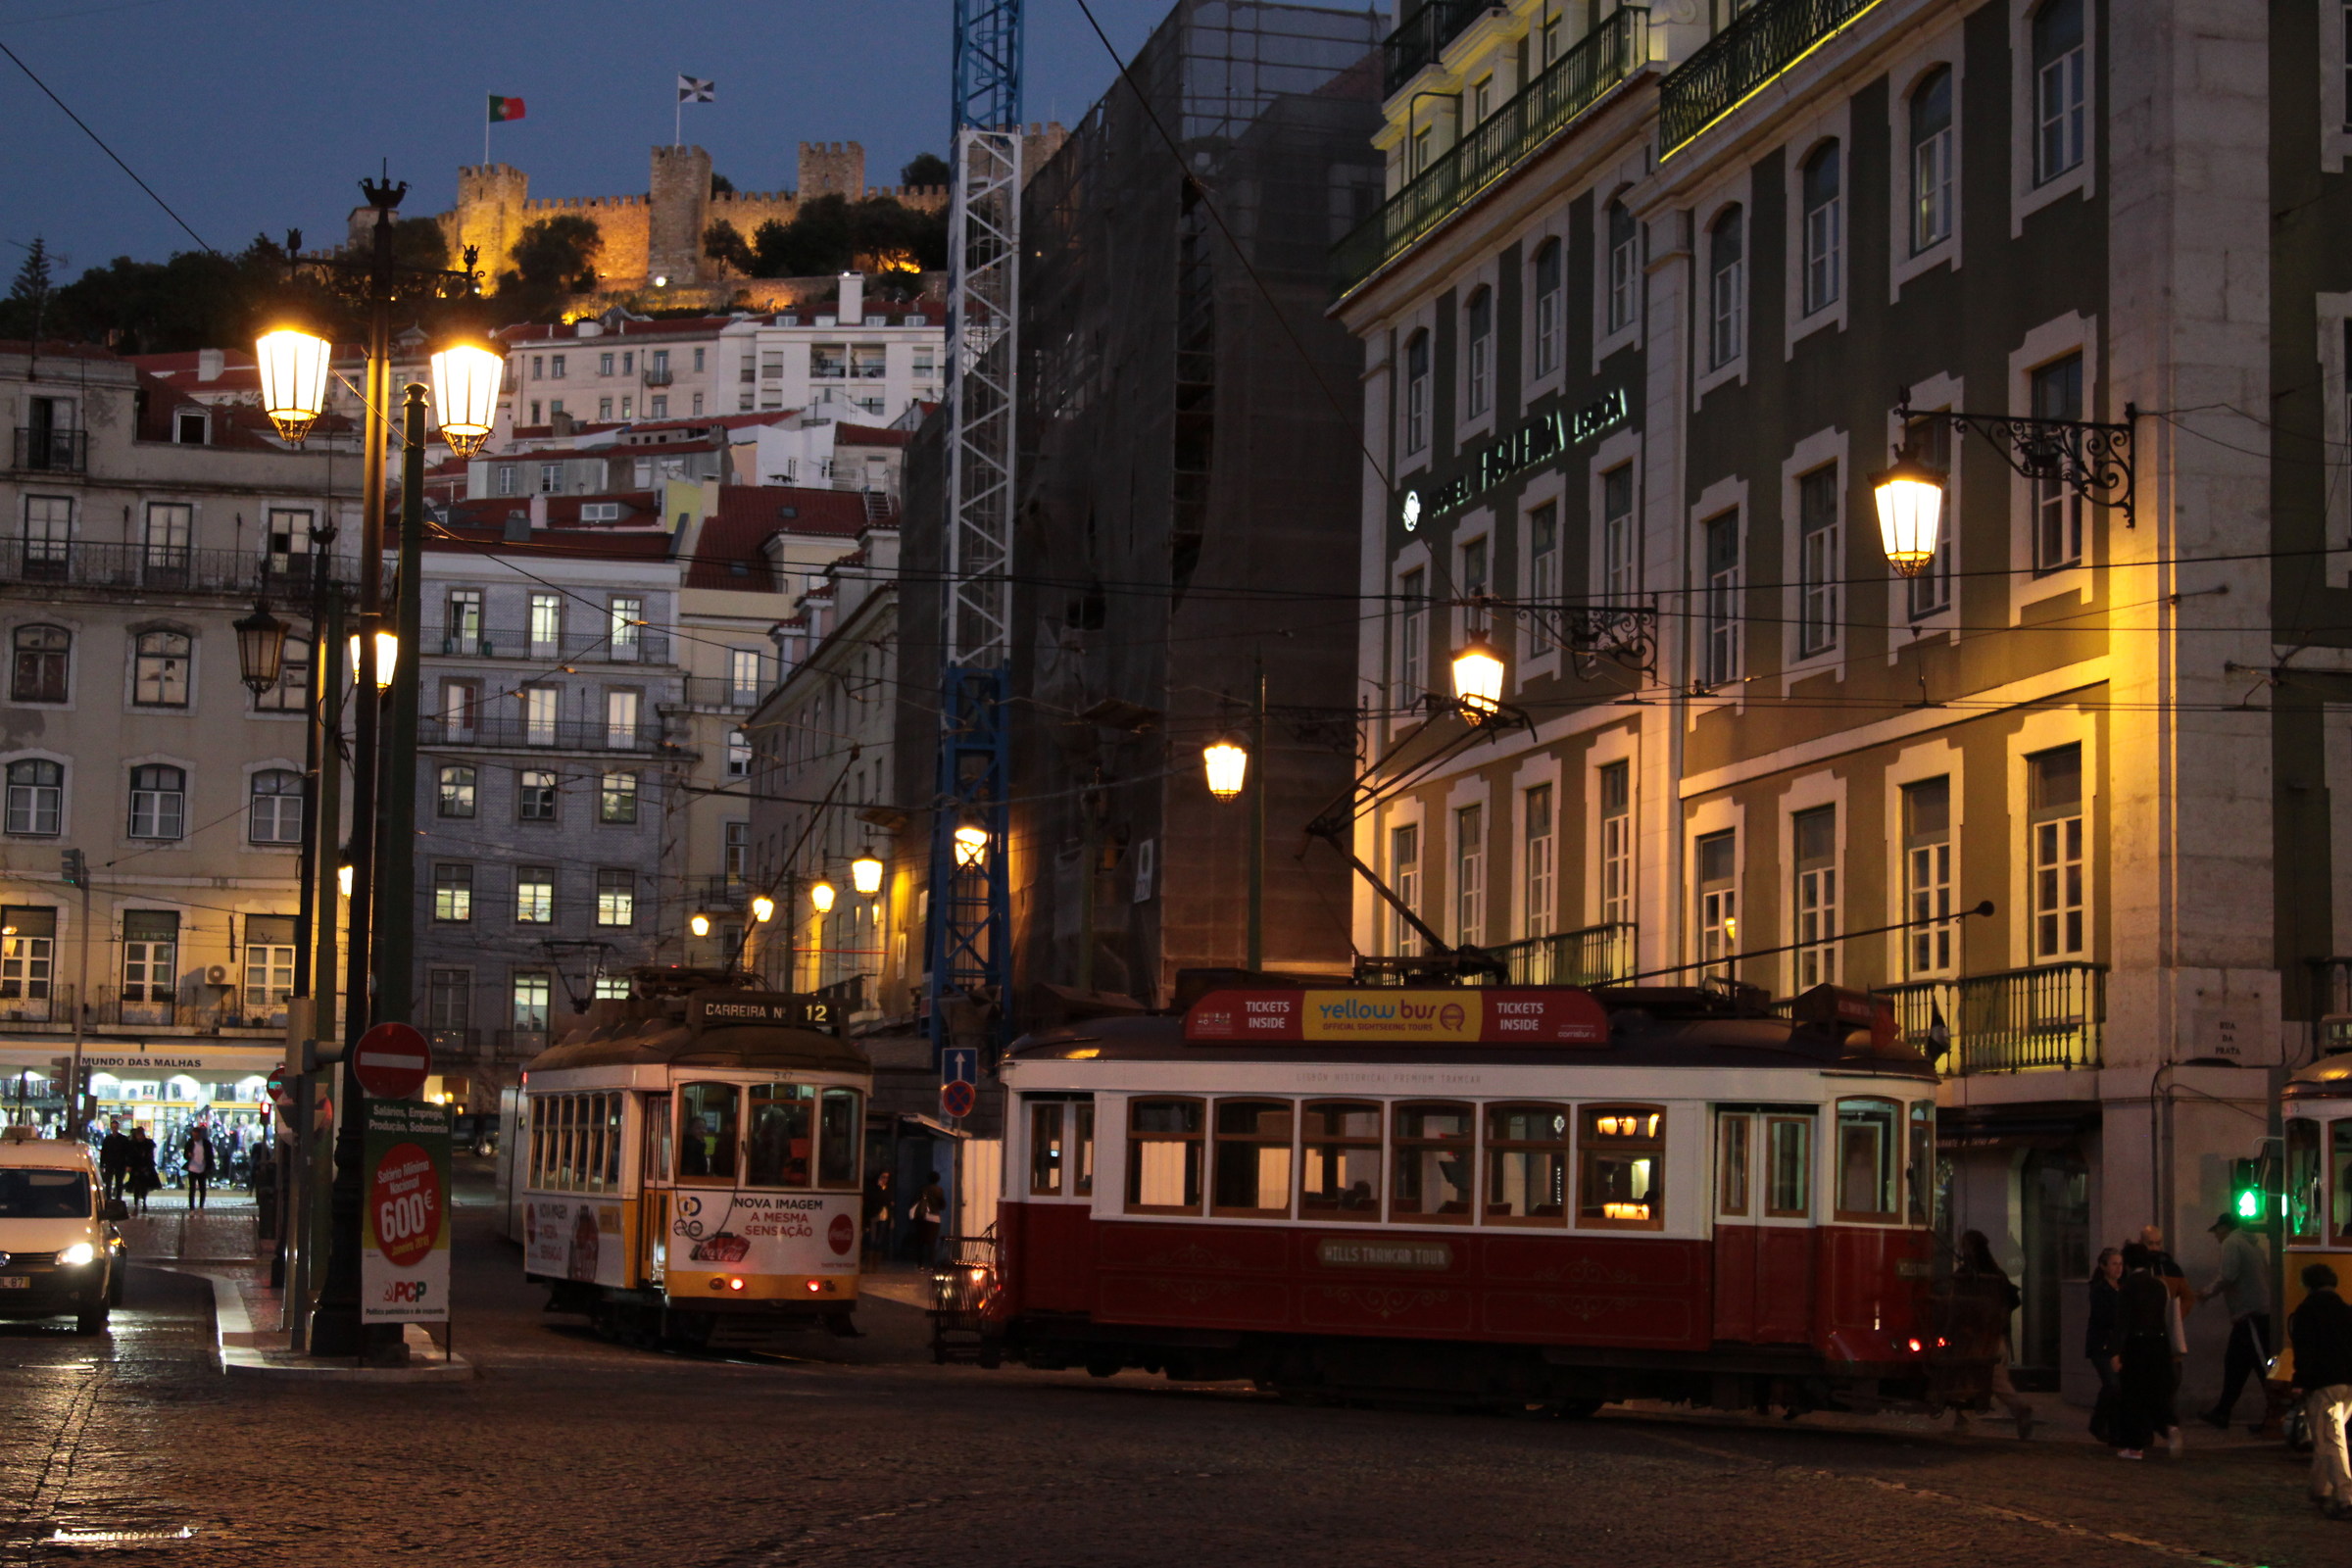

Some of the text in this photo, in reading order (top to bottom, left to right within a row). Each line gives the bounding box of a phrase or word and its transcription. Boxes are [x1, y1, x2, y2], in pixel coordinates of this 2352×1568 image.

[706, 1003, 766, 1018] CARREIRA
[805, 1004, 829, 1022] 12
[1246, 1001, 1291, 1013] TICKETS
[1399, 999, 1437, 1019] bus
[1496, 1002, 1544, 1015] TICKETS
[1249, 1017, 1286, 1029] INSIDE
[1322, 1022, 1434, 1032] OFFICIAL SIGHTSEEING TOURS
[1499, 1018, 1540, 1031] INSIDE
[2219, 1021, 2236, 1030] RUA
[2215, 1047, 2241, 1055] PRATA
[81, 1057, 202, 1068] MUNDO DAS MALHAS
[734, 1198, 823, 1210] NOVA IMAGEM
[751, 1212, 808, 1223] A MESMA
[745, 1225, 813, 1239] SENSAÇÃO
[1324, 1247, 1360, 1262] HILLS
[1414, 1249, 1446, 1265] TOUR
[394, 1281, 427, 1302] PCP
